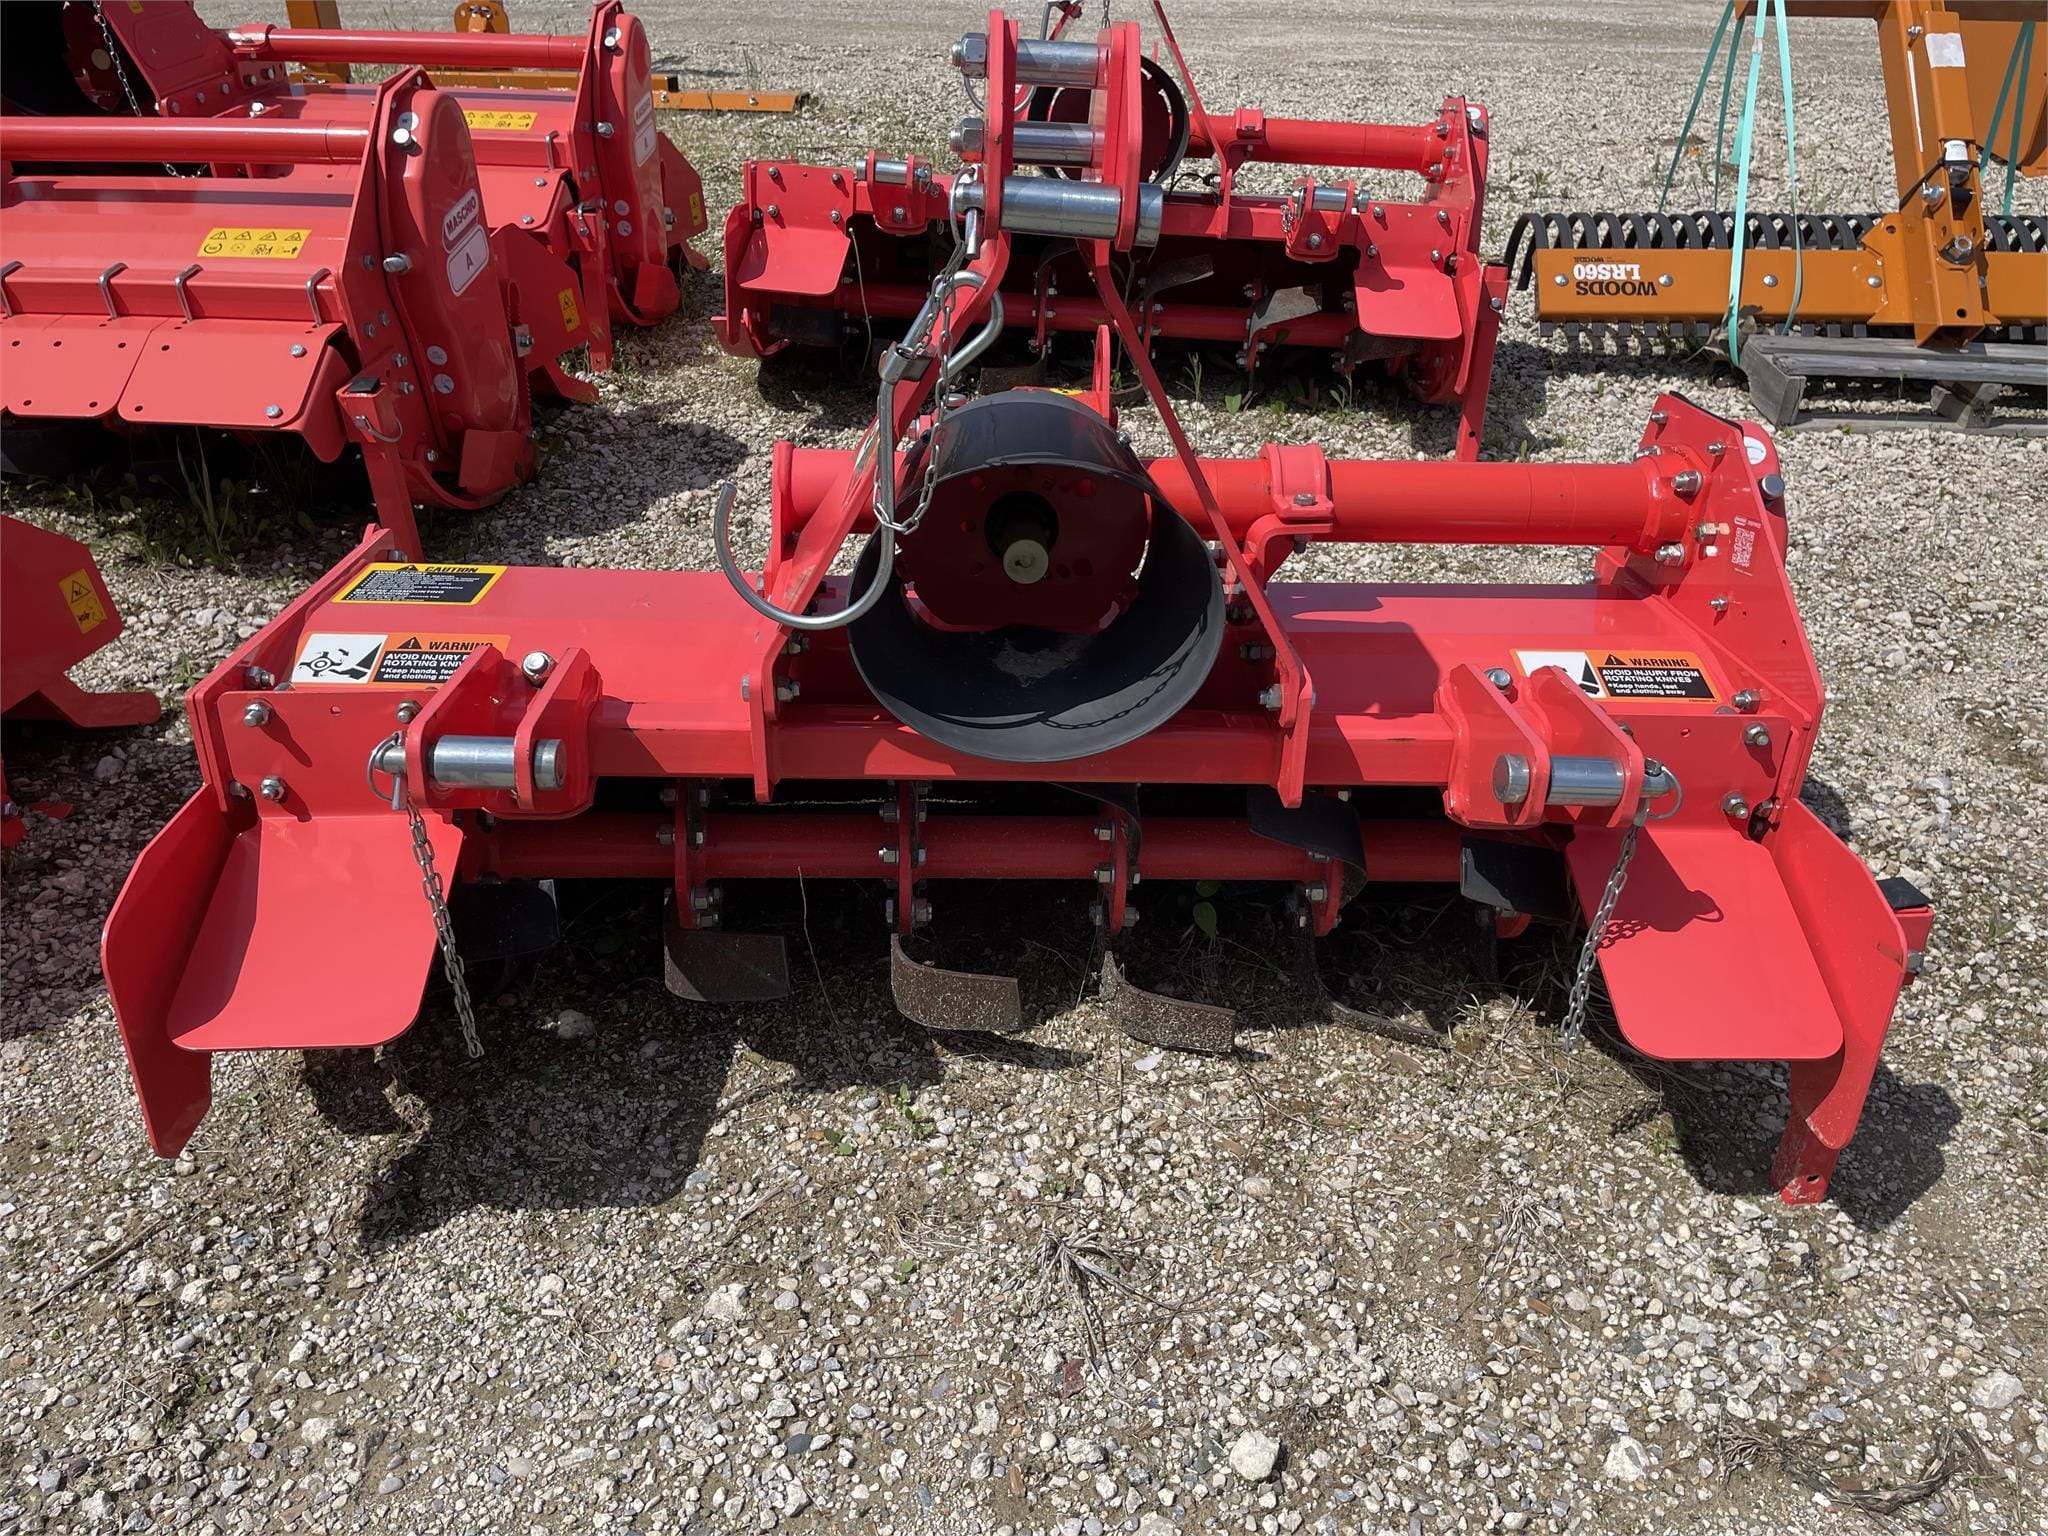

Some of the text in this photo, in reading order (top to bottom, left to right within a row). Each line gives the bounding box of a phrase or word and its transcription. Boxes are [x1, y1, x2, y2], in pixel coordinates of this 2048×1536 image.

[446, 196, 477, 233] MASCHIO
[465, 252, 474, 270] A
[1573, 264, 1641, 280] LRS60
[1576, 281, 1657, 296] WOODS
[425, 566, 479, 574] CAUTION
[1629, 658, 1690, 667] WARNING
